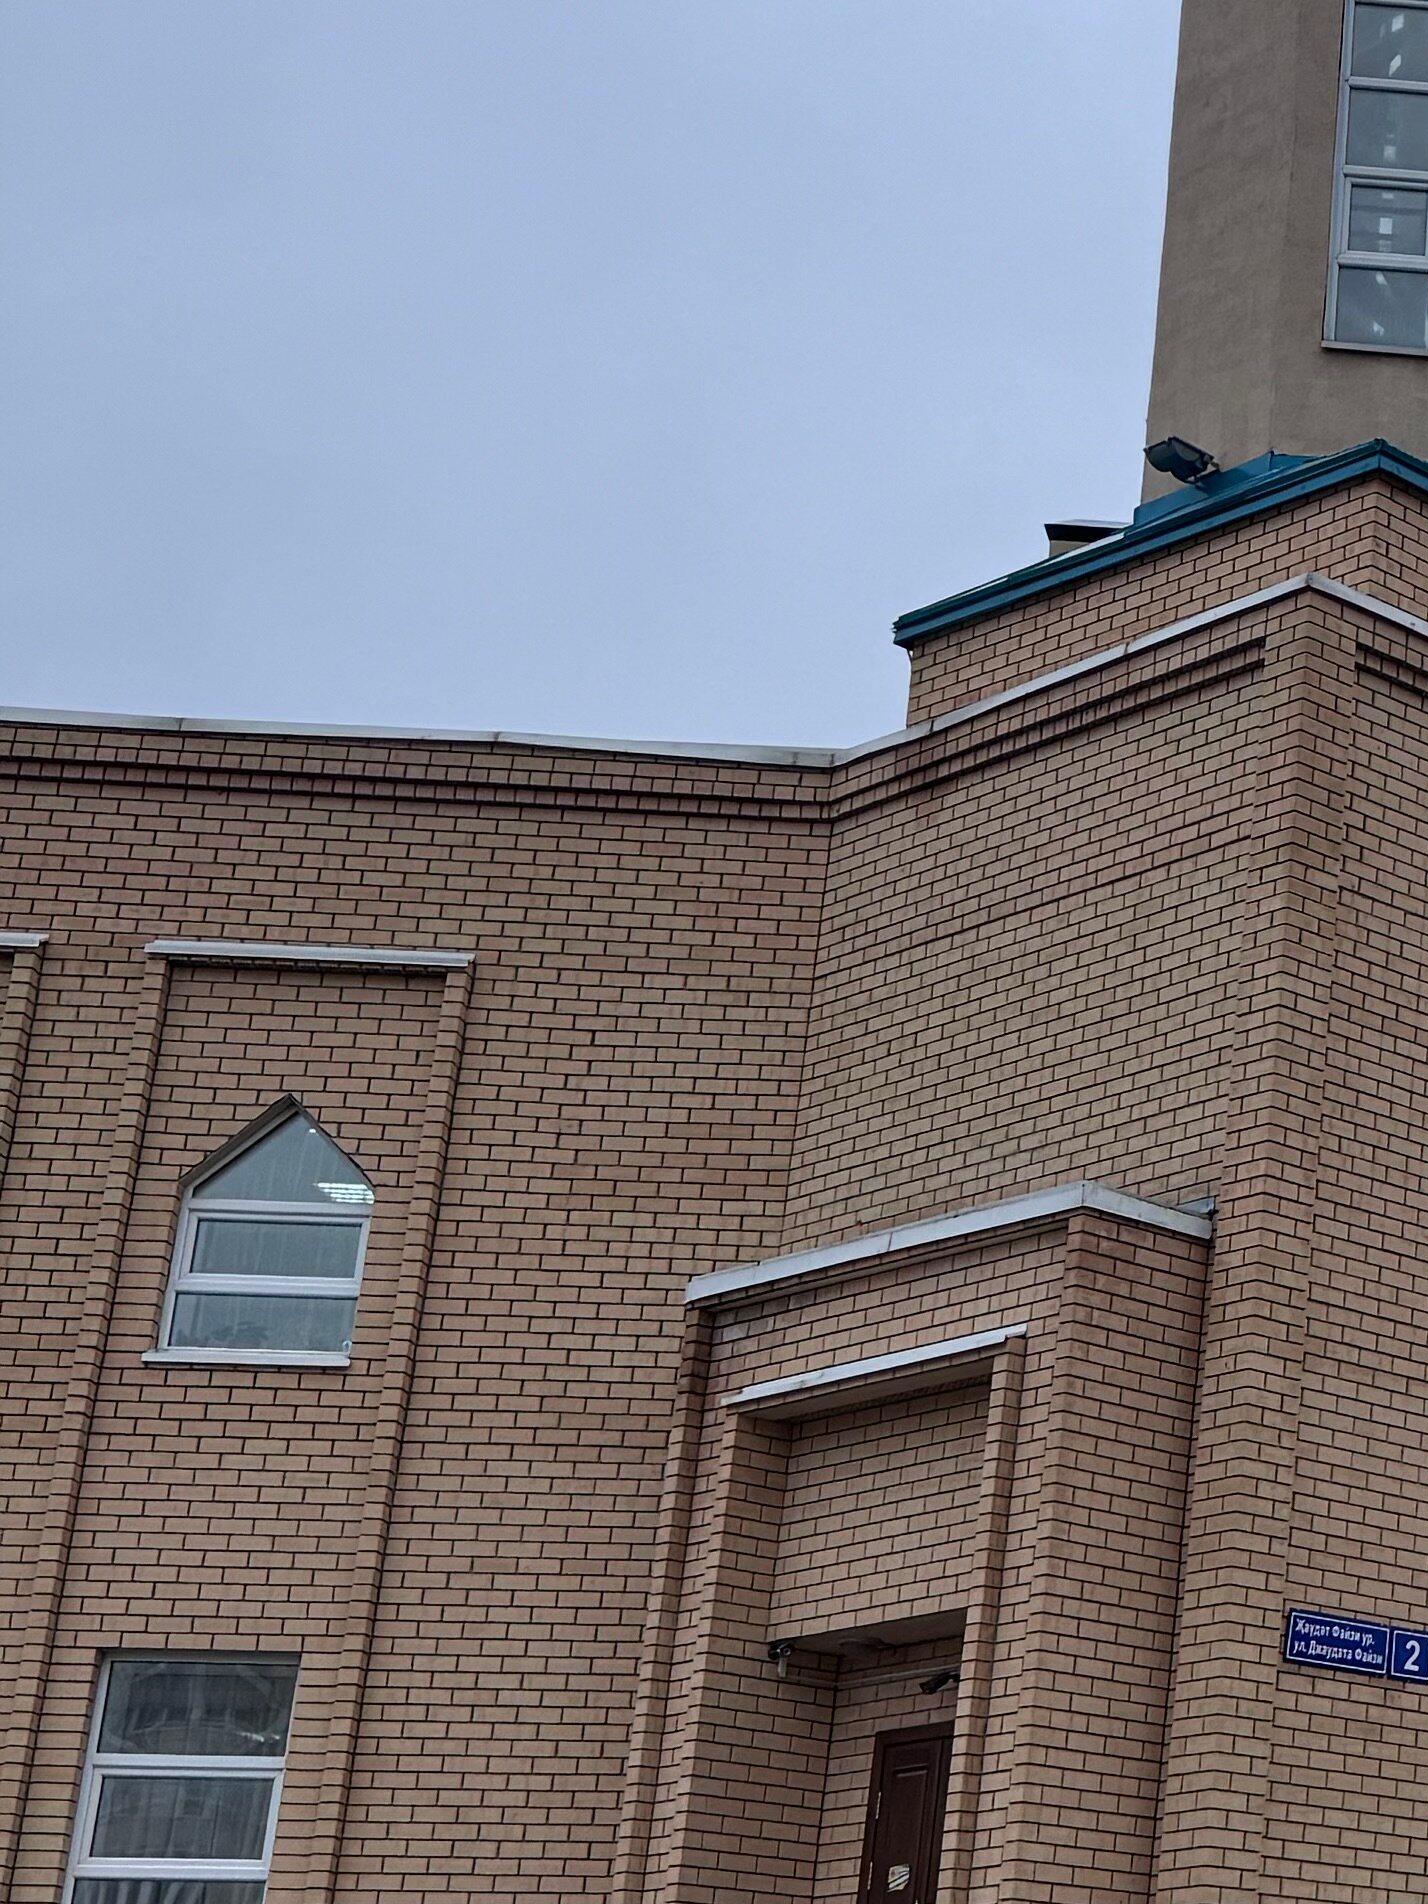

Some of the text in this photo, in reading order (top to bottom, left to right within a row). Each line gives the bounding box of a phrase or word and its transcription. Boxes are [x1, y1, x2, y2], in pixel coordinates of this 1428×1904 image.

[1292, 1640, 1307, 1654] ул.
[1307, 1640, 1352, 1659] Джаудата
[1403, 1639, 1421, 1672] 2
